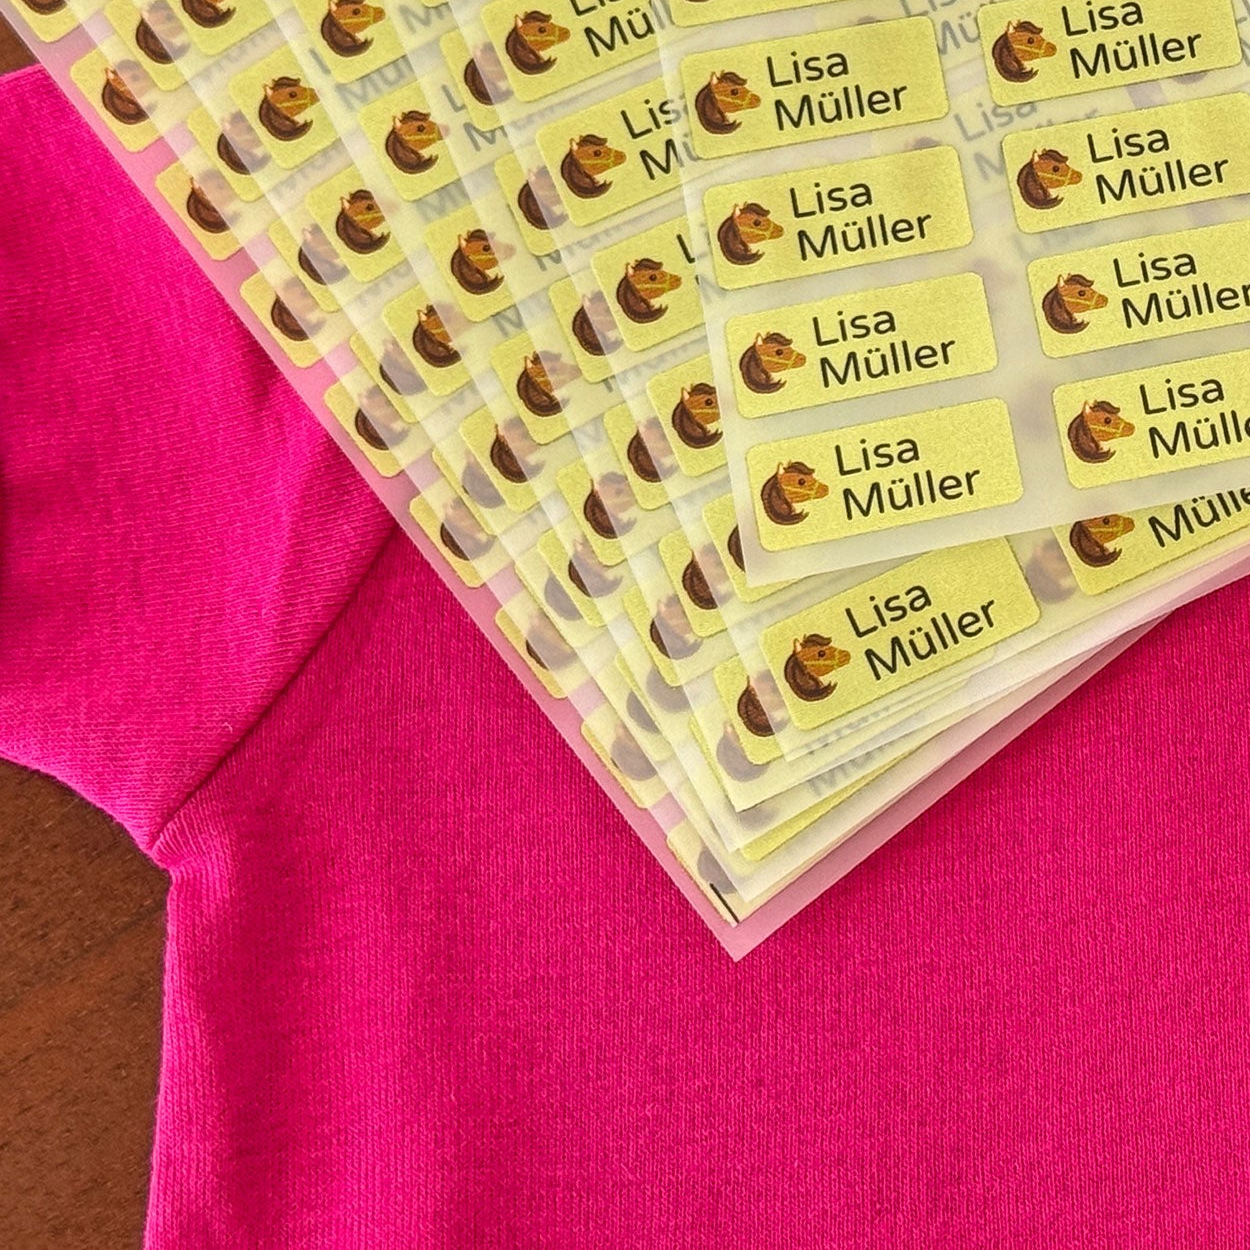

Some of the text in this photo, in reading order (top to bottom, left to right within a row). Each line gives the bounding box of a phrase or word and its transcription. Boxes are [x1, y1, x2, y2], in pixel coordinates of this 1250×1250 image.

[1061, 0, 1144, 37] Lisa
[766, 50, 850, 88] Lisa
[1069, 32, 1202, 80] Müller
[620, 98, 682, 140] Lis
[774, 84, 908, 131] Müller
[1086, 127, 1170, 164] Lisa
[789, 182, 873, 219] Lisa
[1095, 158, 1229, 205] Müller
[796, 213, 932, 262] Müller
[1112, 252, 1197, 288] Lisa
[812, 310, 897, 347] Lisa
[819, 339, 956, 389] Müller
[1139, 378, 1225, 415] Lisa
[834, 438, 920, 477] Lisa
[842, 469, 981, 521] Müller
[844, 585, 932, 639] Lisa
[864, 600, 996, 681] Müller
